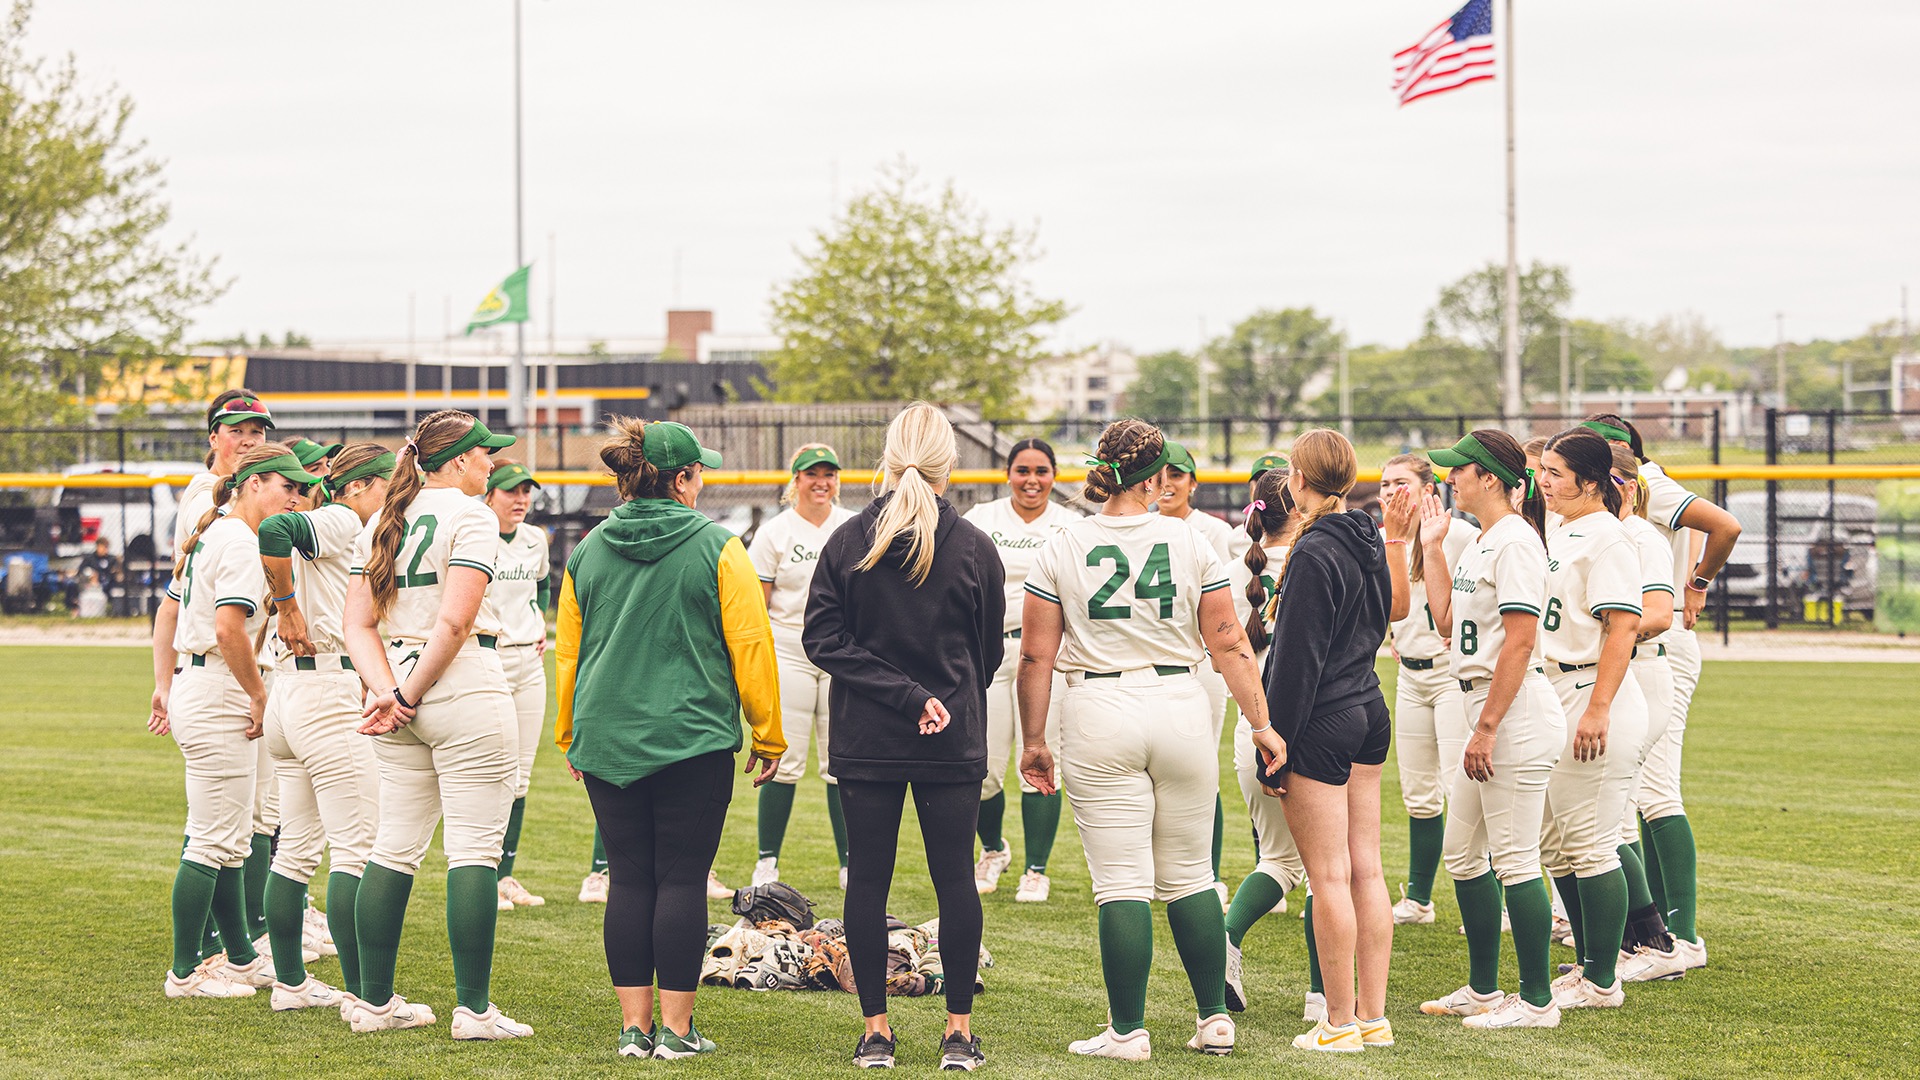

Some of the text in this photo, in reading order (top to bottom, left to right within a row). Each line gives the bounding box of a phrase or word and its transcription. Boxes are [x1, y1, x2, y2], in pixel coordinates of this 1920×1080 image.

[494, 562, 538, 581] outhe
[1086, 542, 1177, 619] 24
[1543, 597, 1563, 632] 6
[1460, 619, 1478, 656] 8
